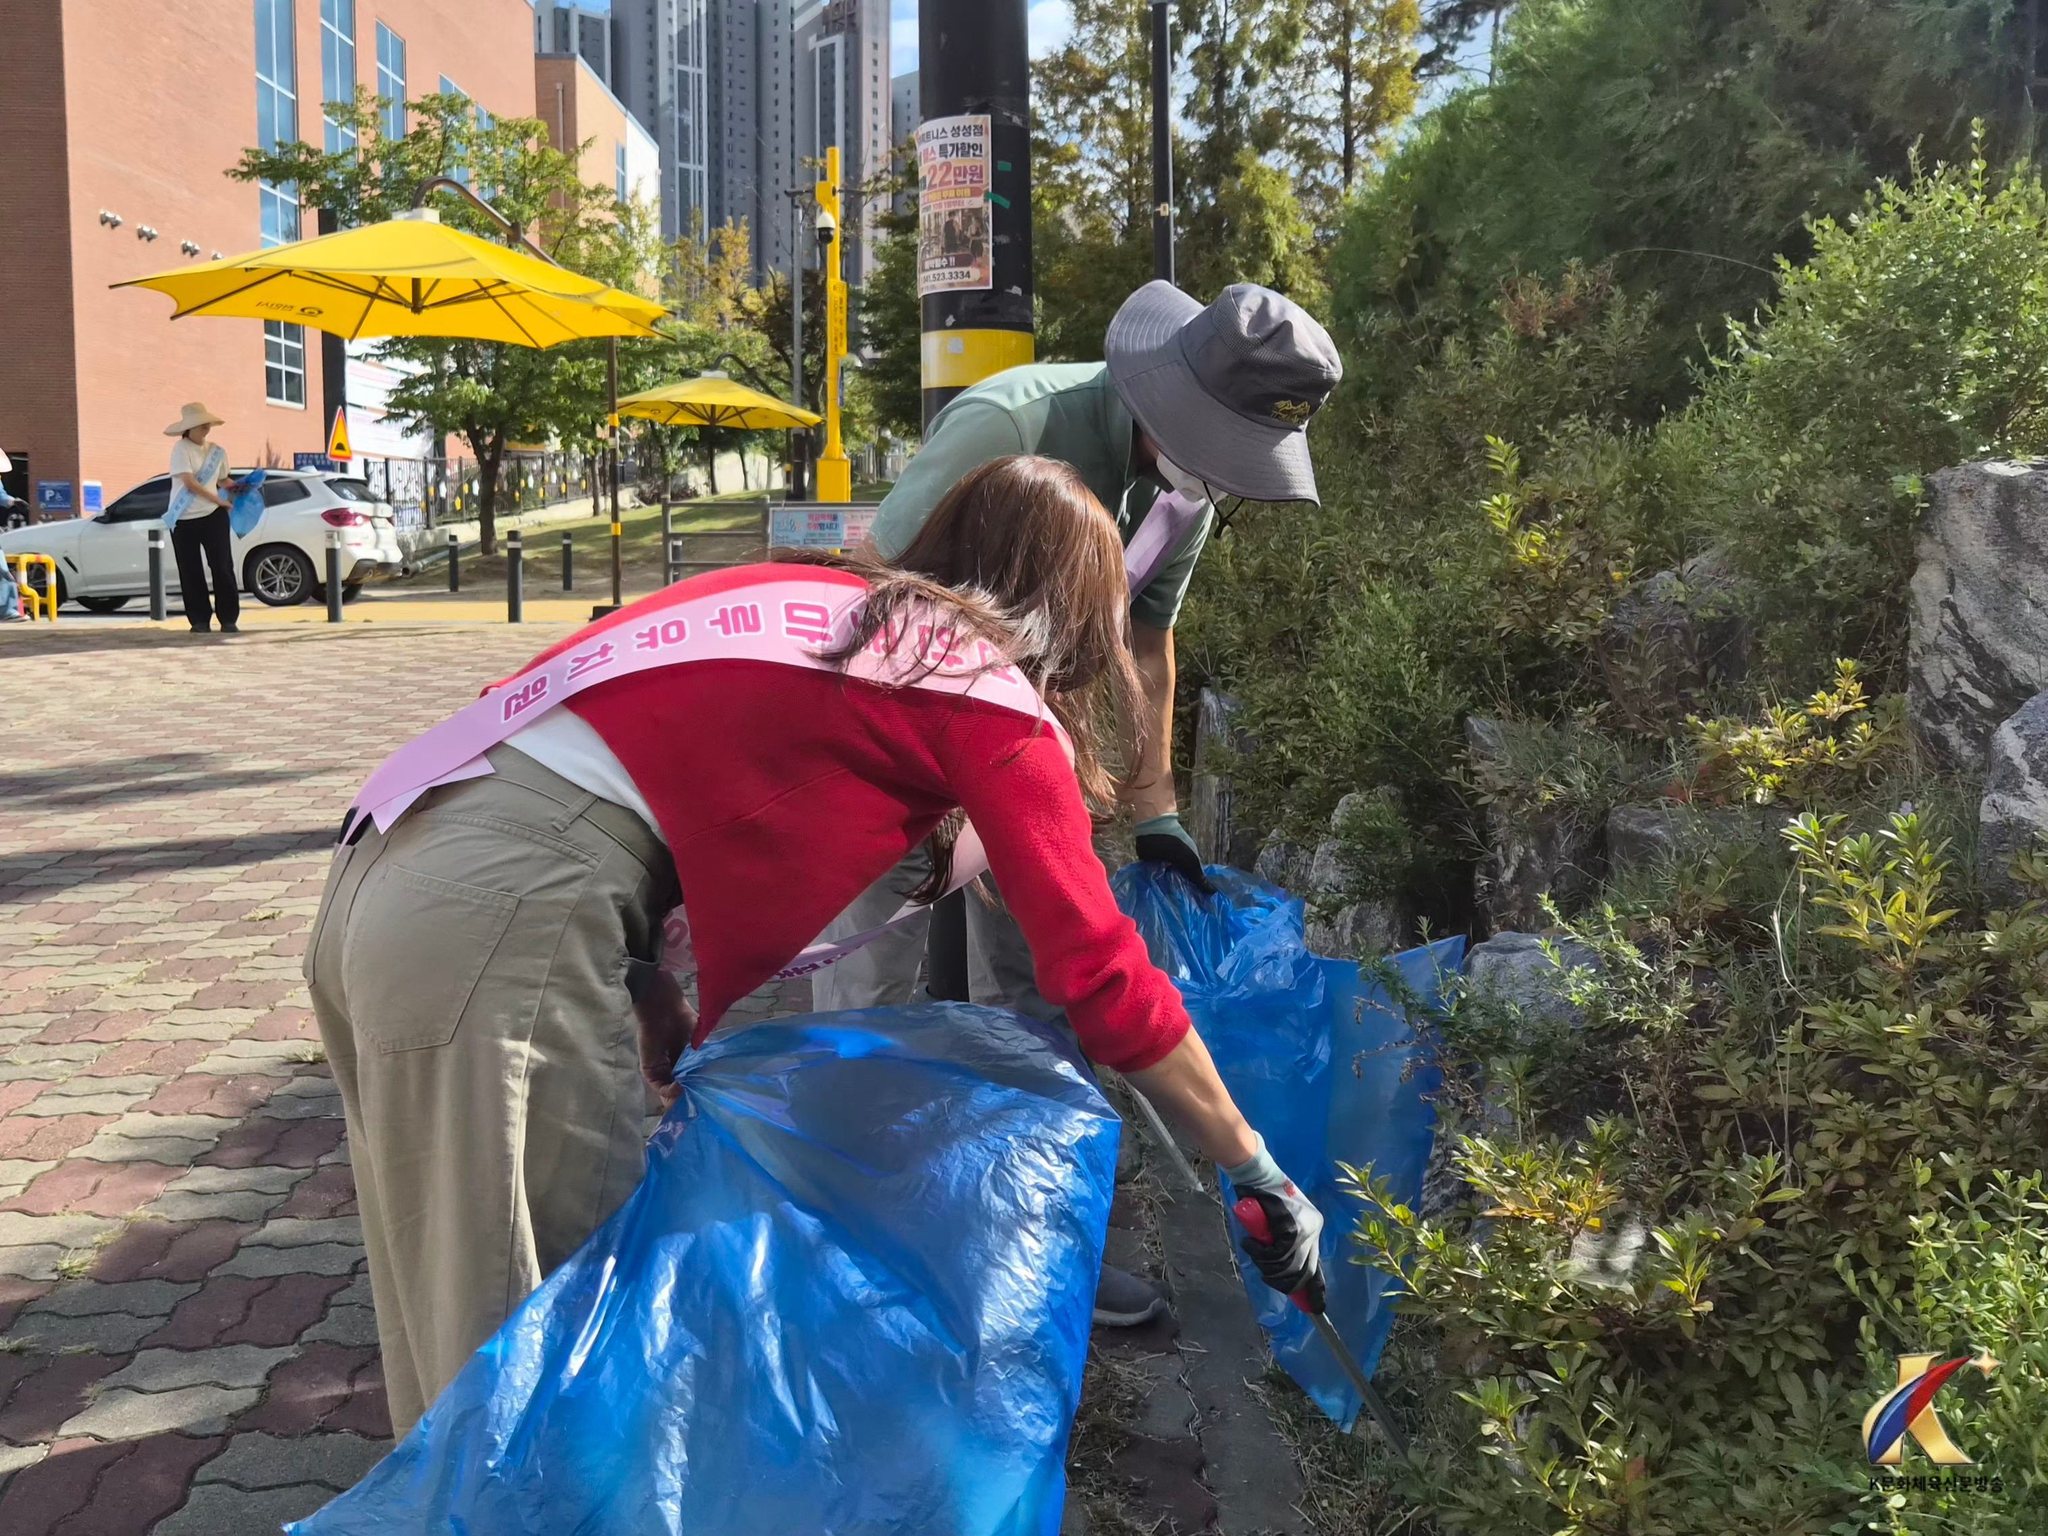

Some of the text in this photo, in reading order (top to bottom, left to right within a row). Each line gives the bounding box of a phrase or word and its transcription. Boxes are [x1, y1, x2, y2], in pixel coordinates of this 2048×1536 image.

[951, 124, 984, 138] 성성점
[939, 142, 983, 159] 특가할인
[927, 161, 984, 190] 22만원
[45, 489, 55, 501] P
